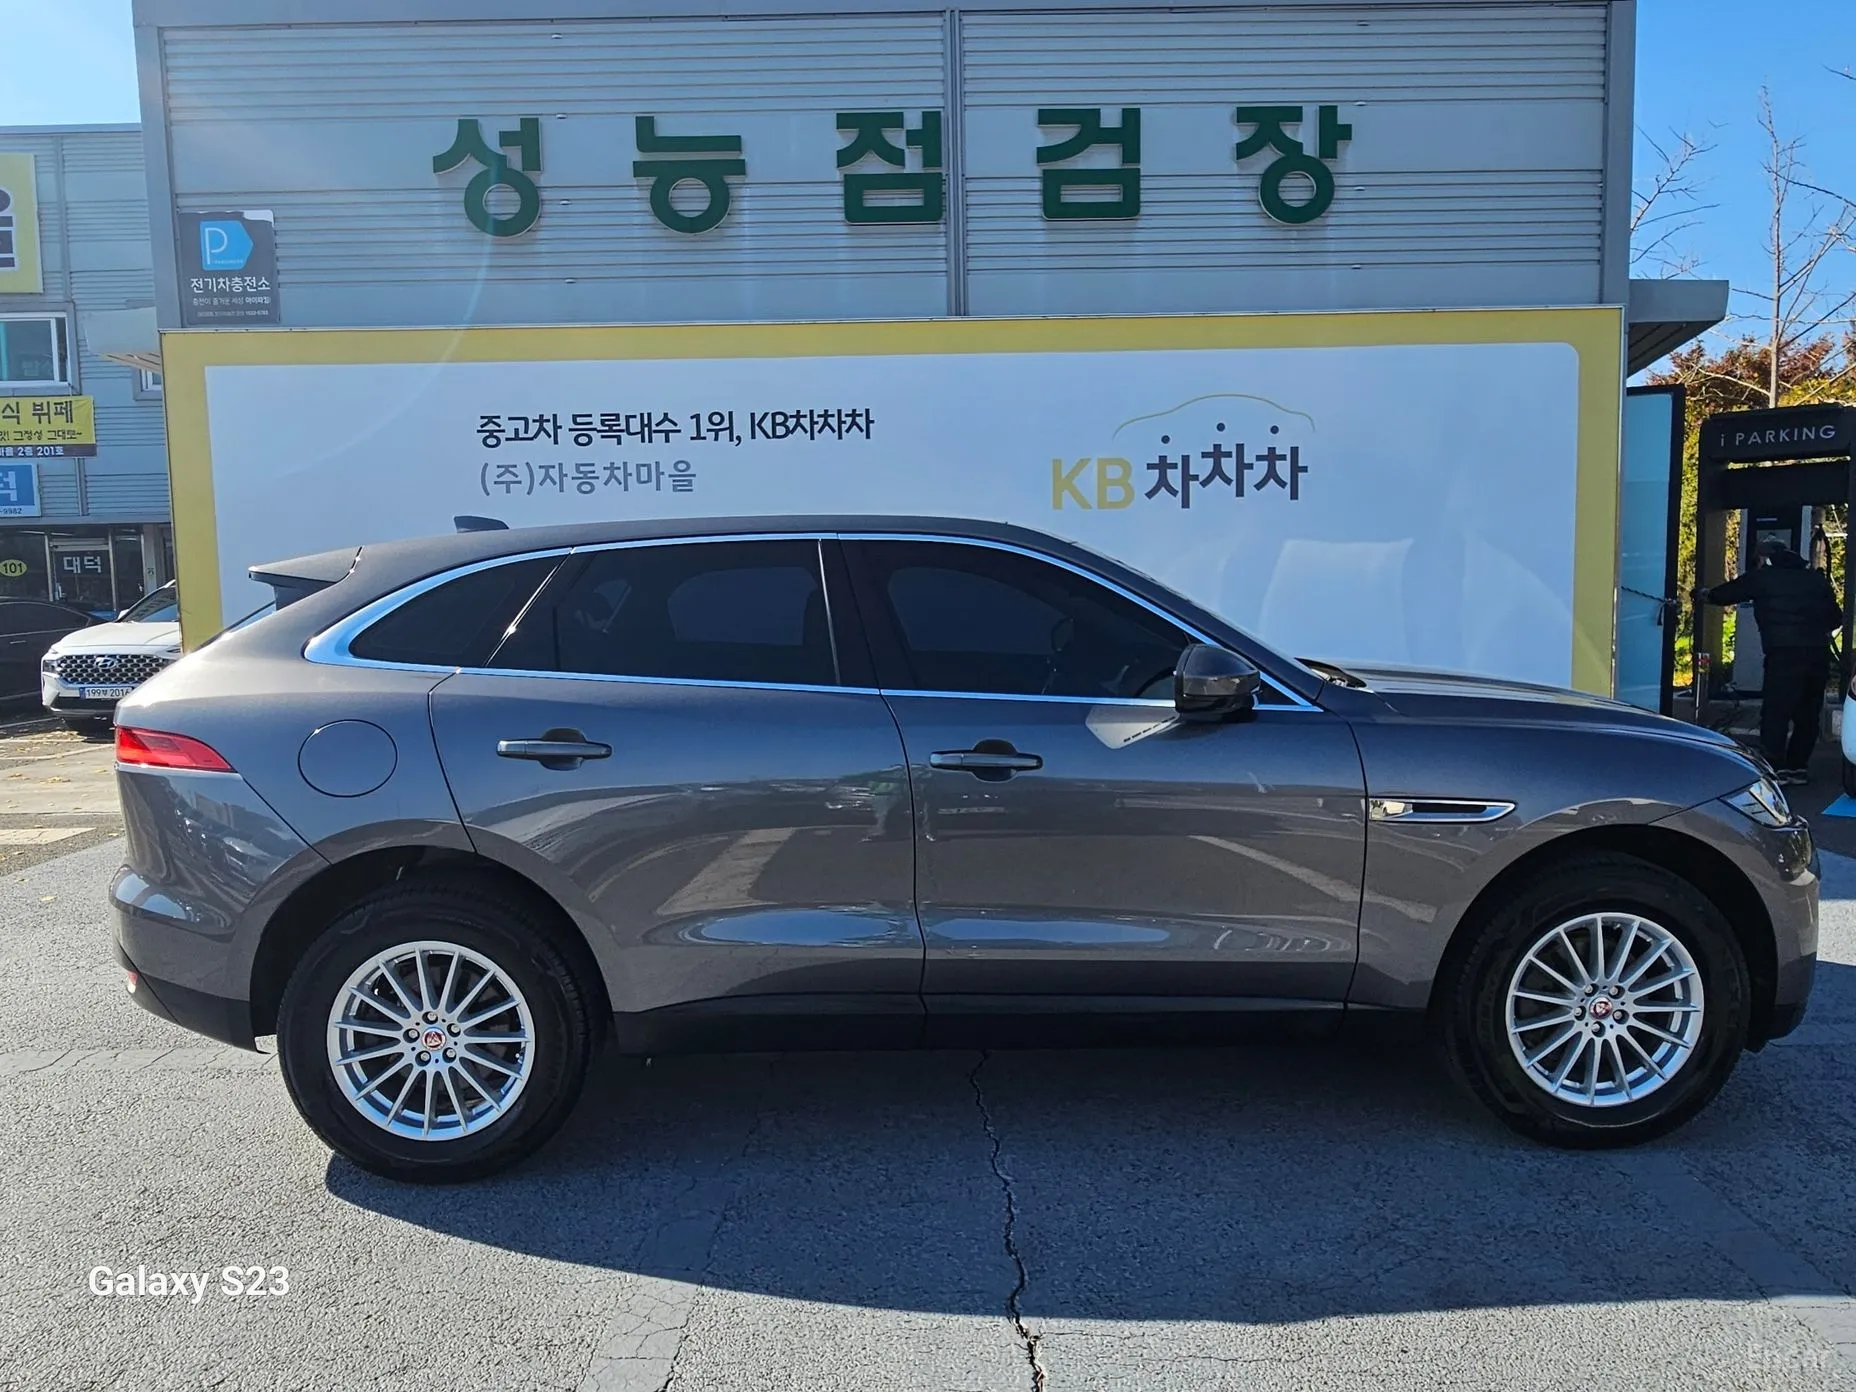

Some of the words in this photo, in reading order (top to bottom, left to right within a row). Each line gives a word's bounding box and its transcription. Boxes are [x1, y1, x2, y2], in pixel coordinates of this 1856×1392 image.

[190, 276, 271, 293] 전기차충전소
[32, 400, 74, 425] 뷔페
[13, 430, 43, 441] 그정성
[476, 414, 562, 448] 중고차
[568, 411, 682, 446] 등록대수
[689, 410, 742, 447] 1위,
[750, 408, 875, 441] KB차차차
[1736, 425, 1837, 446] PARKING
[37, 446, 64, 456] 201호
[480, 460, 697, 496] (주)자동차마을
[3, 562, 23, 573] 101
[63, 556, 102, 574] 대덕
